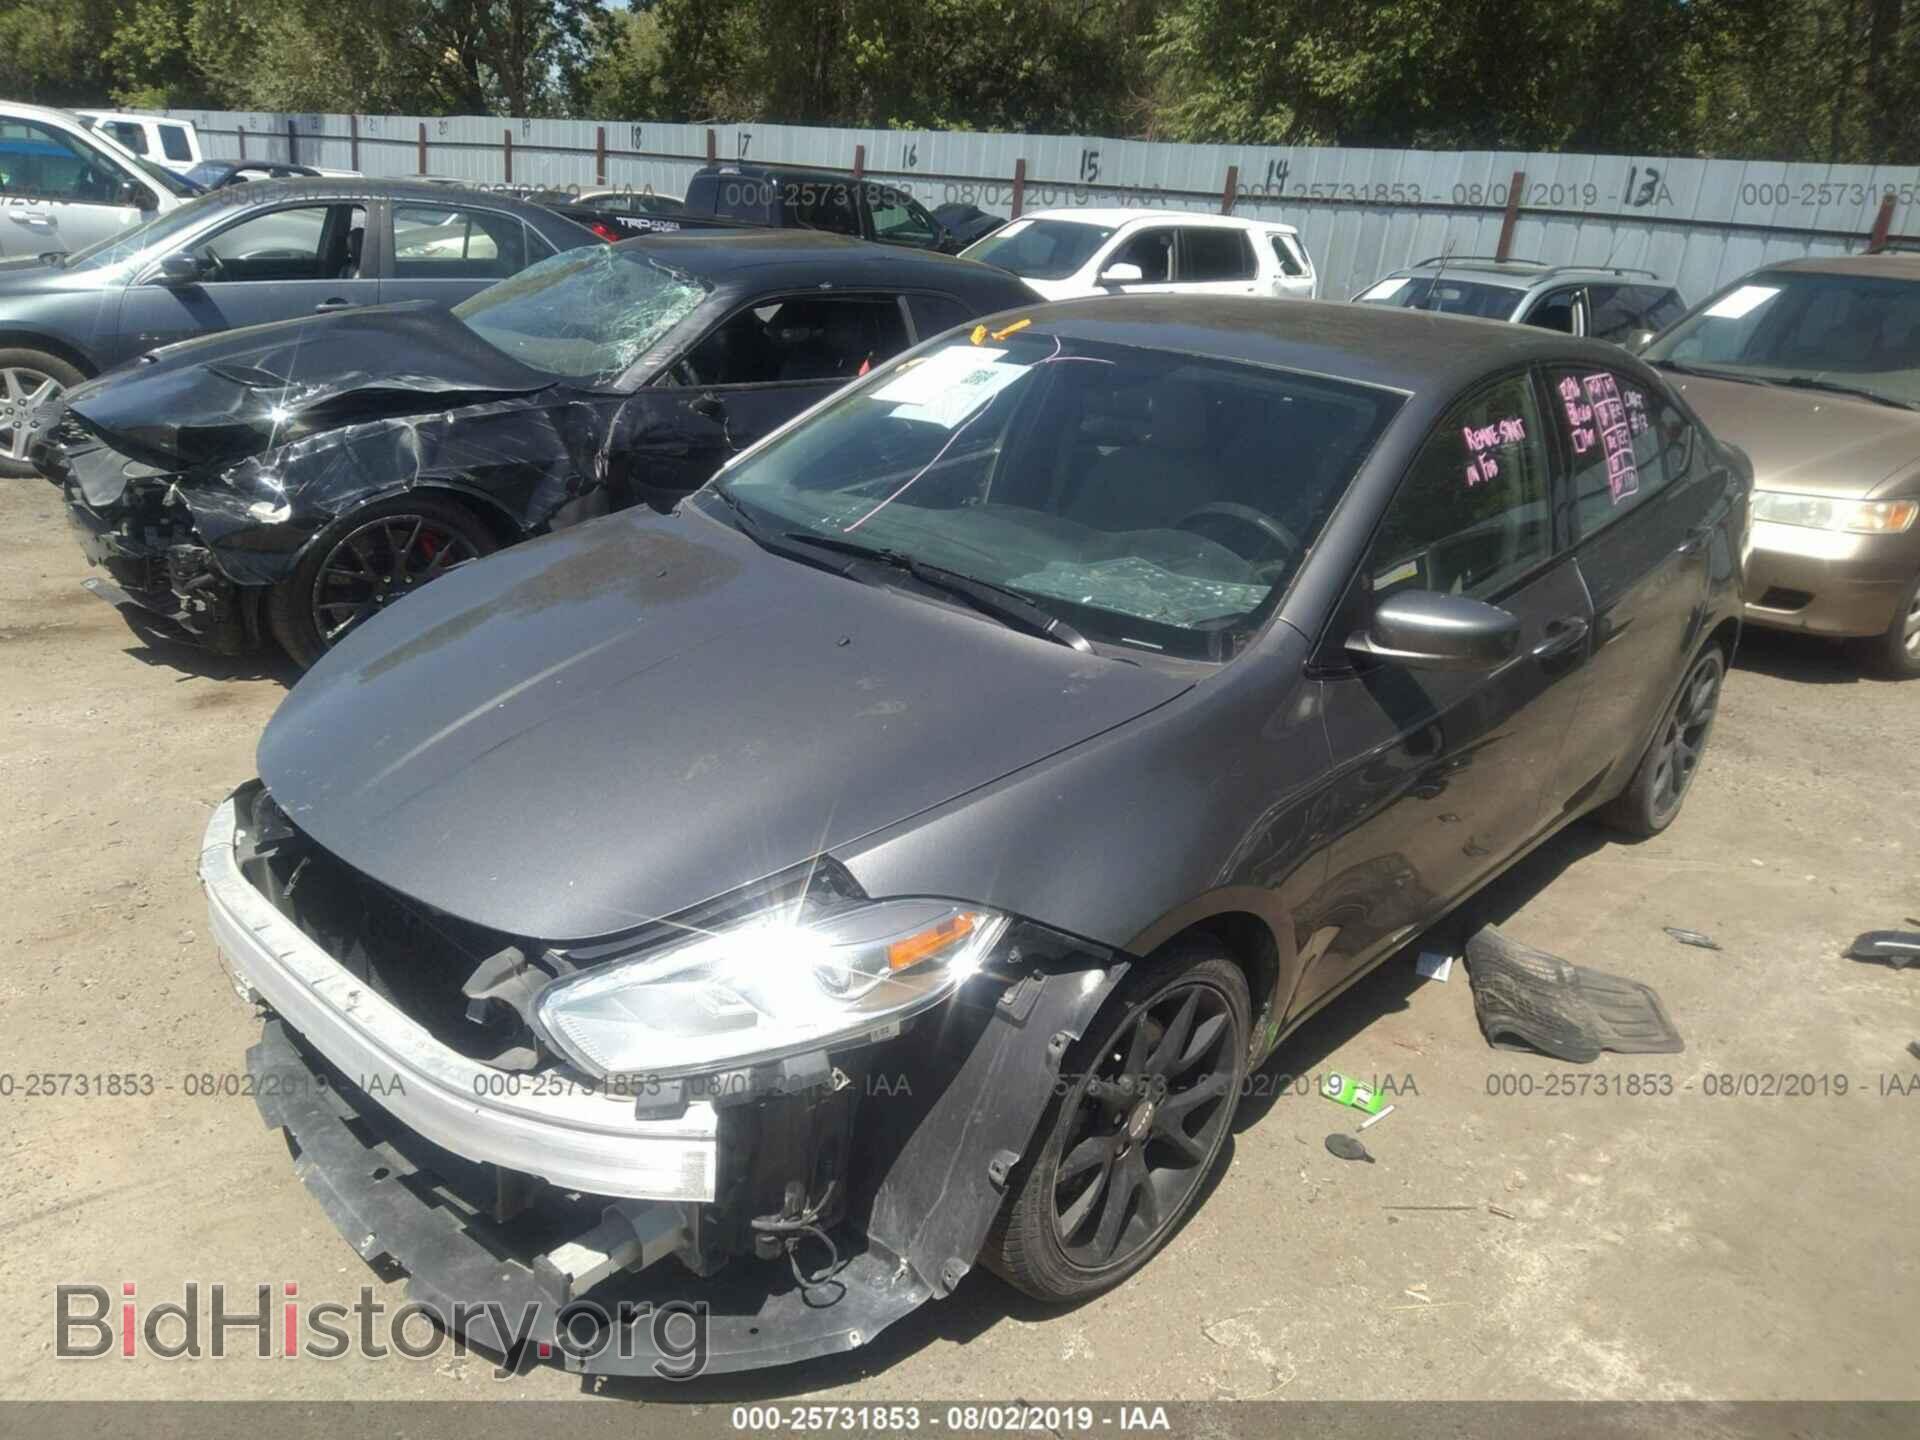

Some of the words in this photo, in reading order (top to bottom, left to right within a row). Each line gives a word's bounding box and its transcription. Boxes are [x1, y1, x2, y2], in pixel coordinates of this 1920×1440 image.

[631, 125, 642, 149] 18
[738, 132, 752, 158] 17
[902, 144, 918, 168] 16
[1080, 150, 1099, 182] 15
[1266, 159, 1289, 193] 14
[1625, 166, 1659, 207] 13
